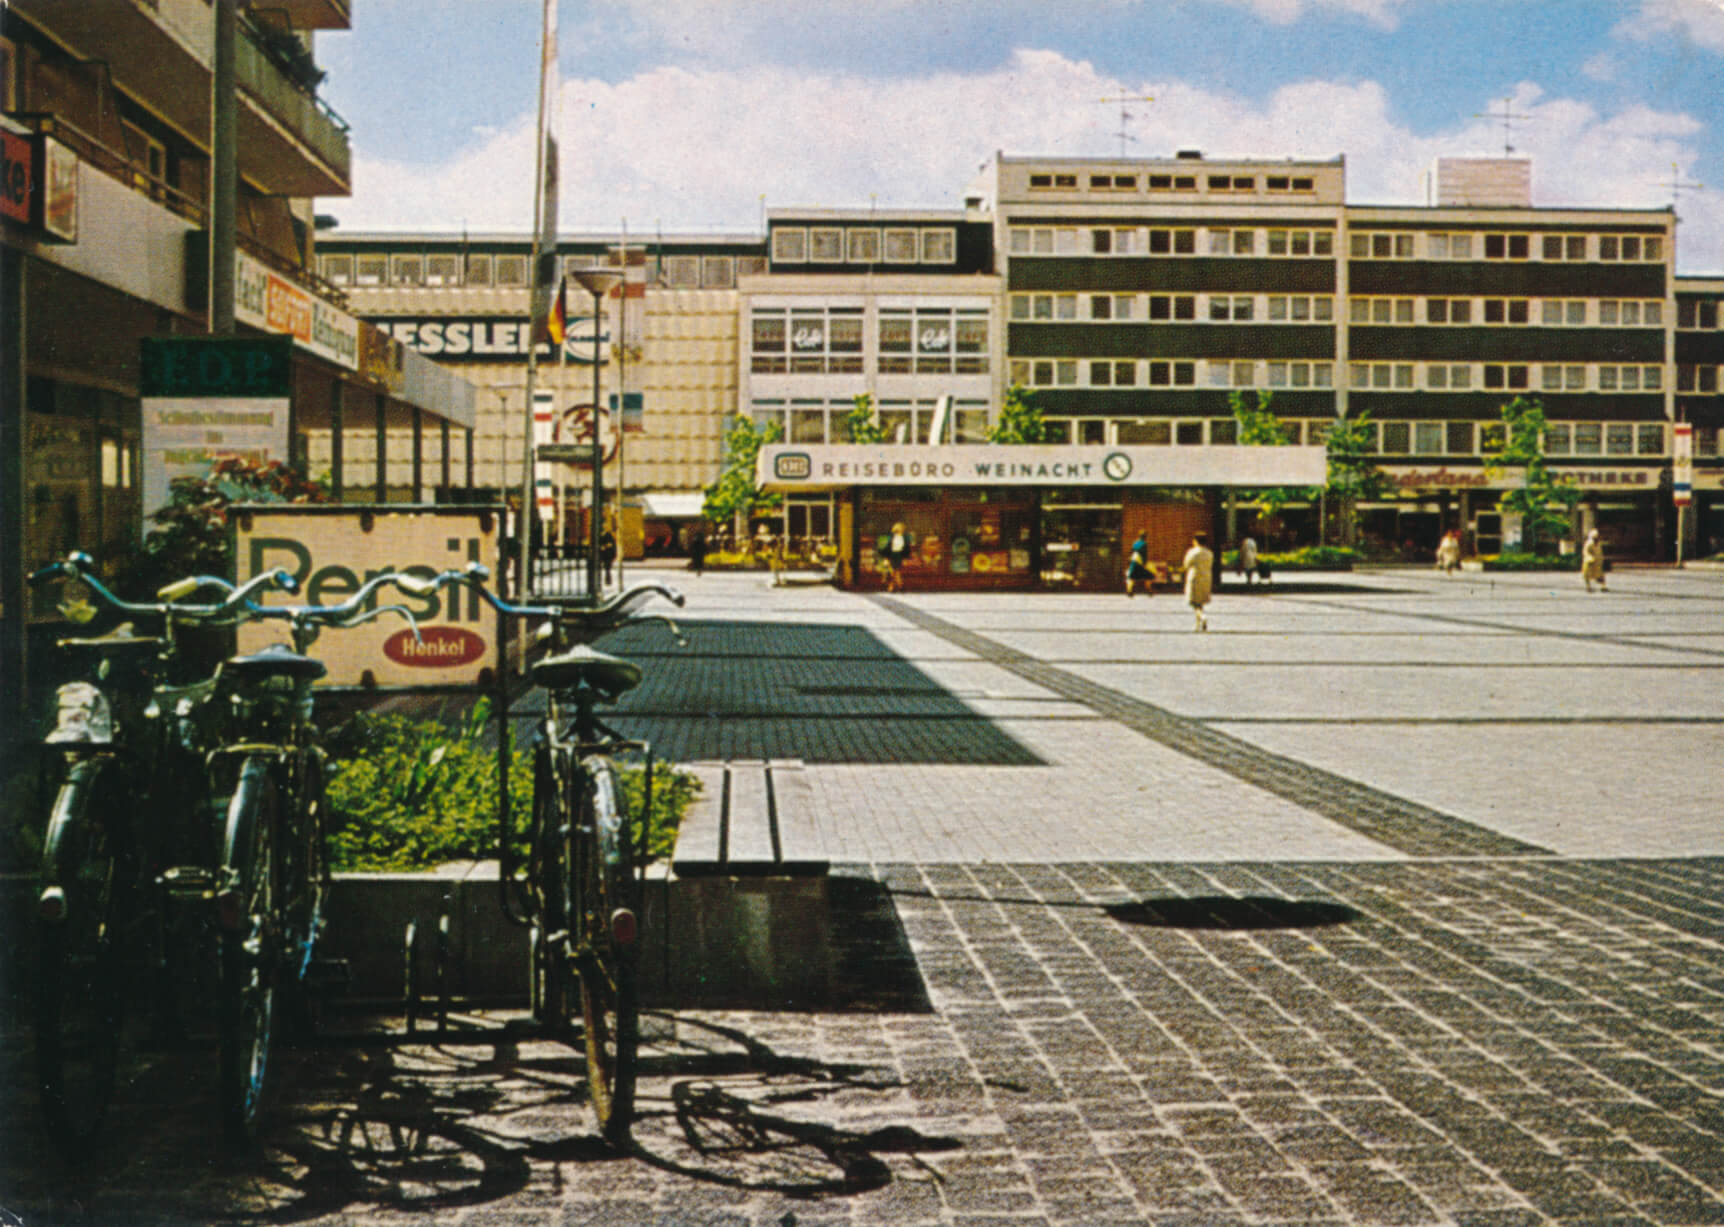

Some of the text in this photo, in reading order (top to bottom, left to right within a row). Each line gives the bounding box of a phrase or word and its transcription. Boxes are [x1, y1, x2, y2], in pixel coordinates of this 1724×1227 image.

[822, 461, 955, 478] REISEBÜRO
[975, 462, 1093, 478] WEINACHT
[249, 537, 481, 623] Persil
[402, 637, 466, 658] Henkel
